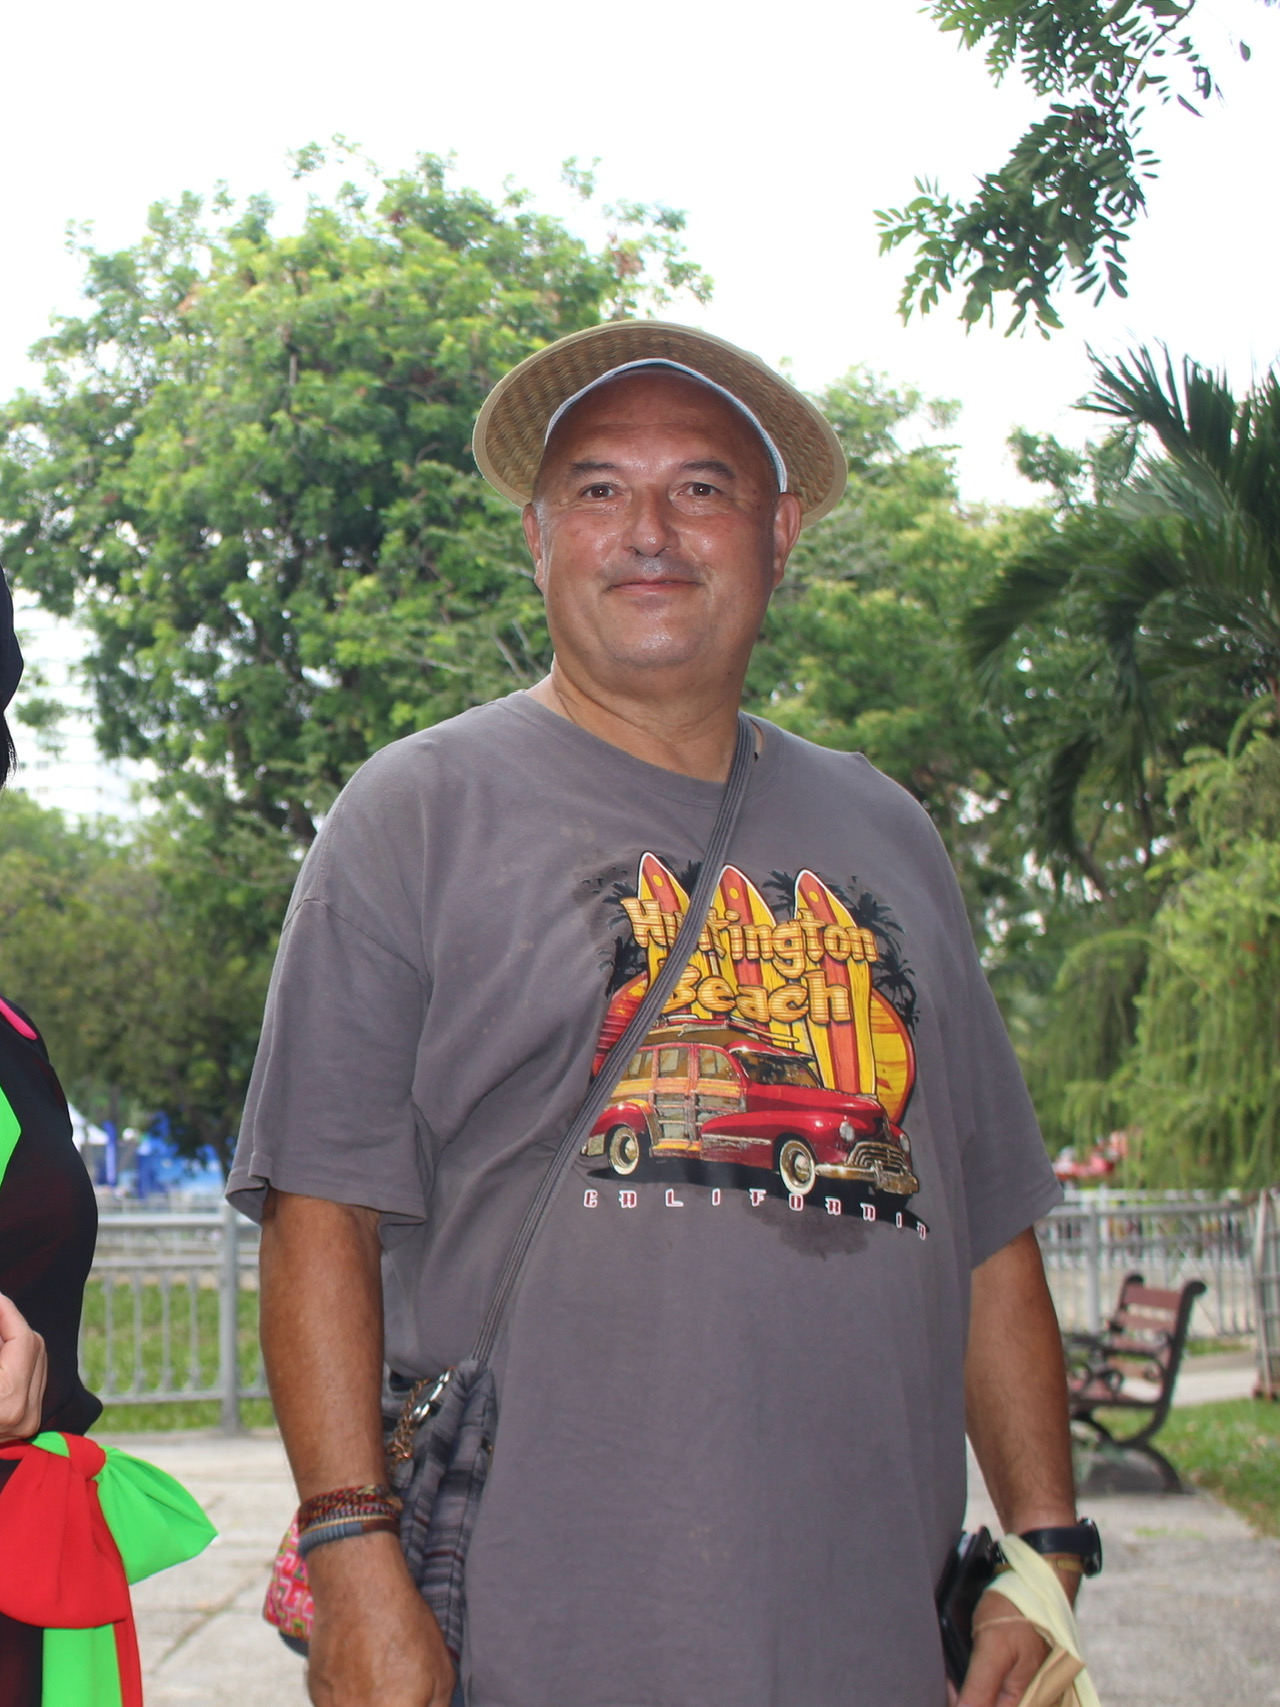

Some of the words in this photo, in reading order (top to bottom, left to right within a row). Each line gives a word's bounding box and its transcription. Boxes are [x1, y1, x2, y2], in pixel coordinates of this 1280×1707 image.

[621, 898, 878, 978] Hutington
[658, 960, 851, 1024] Beach
[583, 1188, 926, 1240] CALIFORNIA
